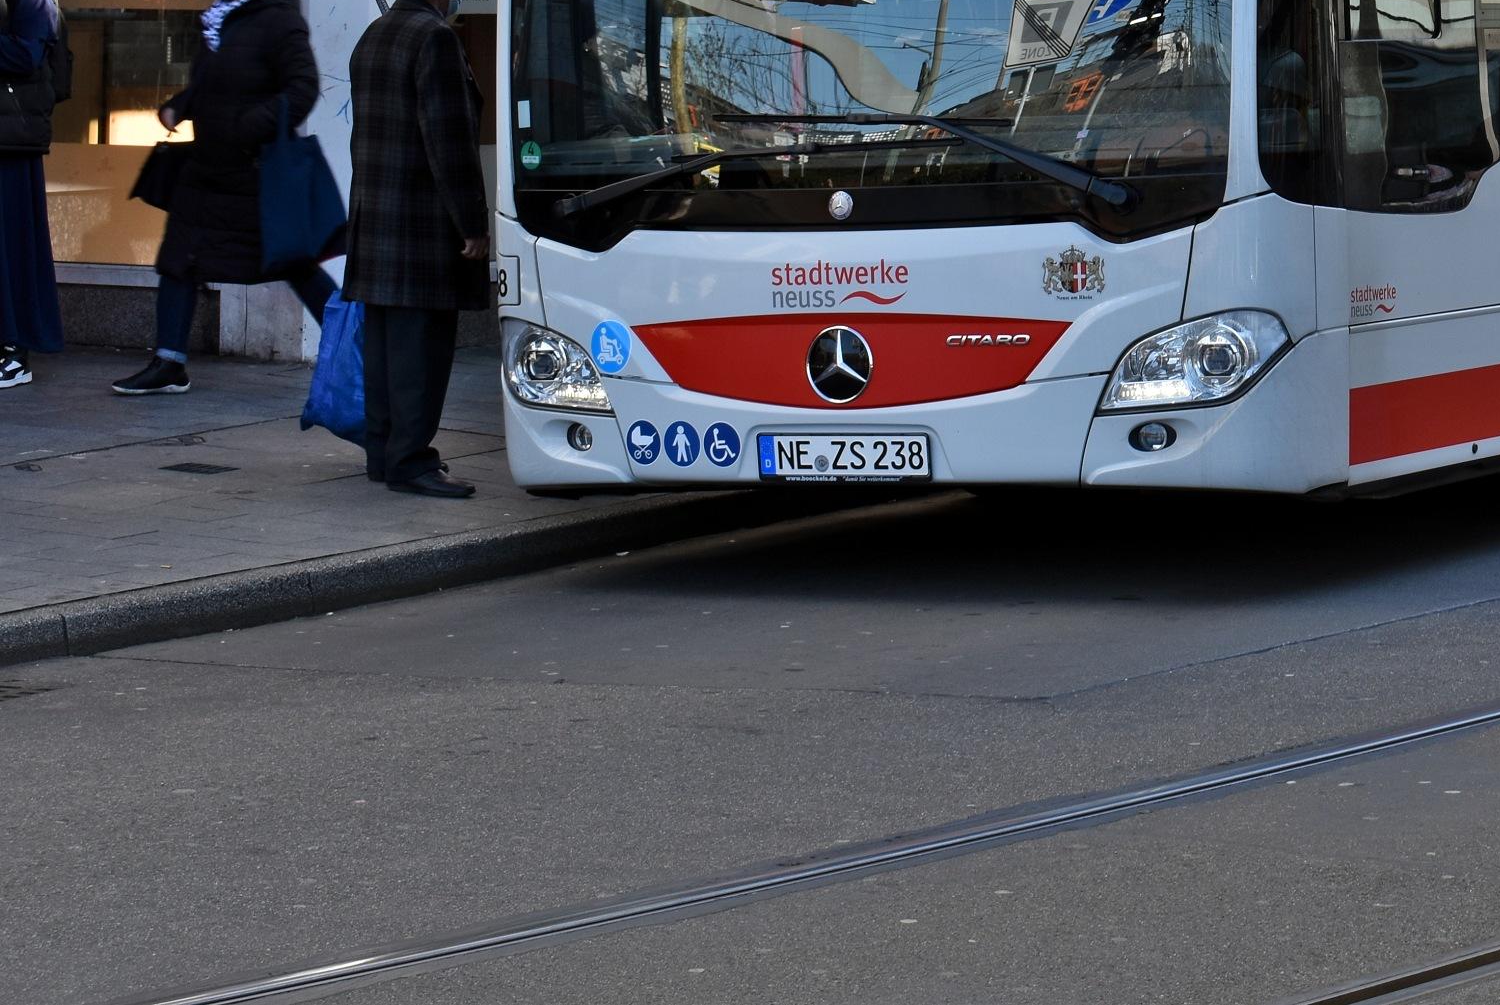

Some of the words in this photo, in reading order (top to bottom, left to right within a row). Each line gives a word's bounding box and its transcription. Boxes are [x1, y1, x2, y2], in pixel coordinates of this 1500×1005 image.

[771, 258, 909, 286] stadtwerke
[772, 289, 836, 308] neuss
[1350, 283, 1397, 303] stadtwerke
[1350, 304, 1373, 318] neuss
[946, 334, 1031, 347] CITARO
[777, 440, 813, 470] NE
[831, 440, 867, 470] ZS
[873, 440, 924, 470] 238
